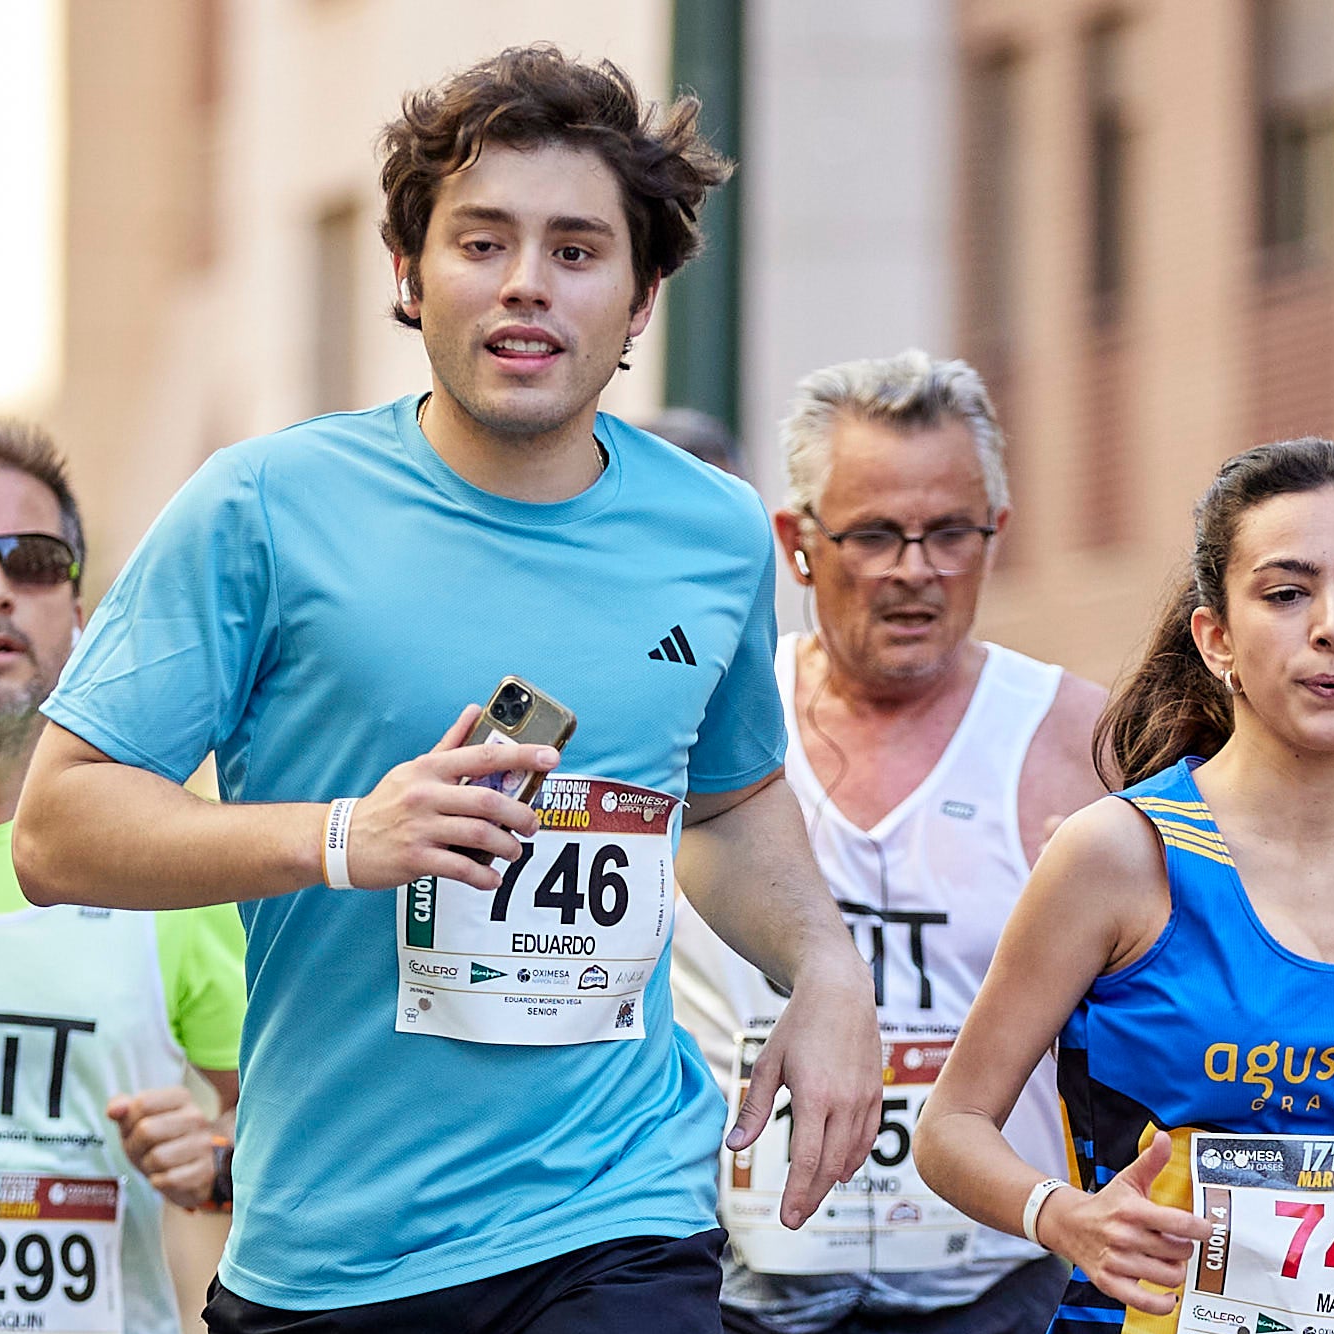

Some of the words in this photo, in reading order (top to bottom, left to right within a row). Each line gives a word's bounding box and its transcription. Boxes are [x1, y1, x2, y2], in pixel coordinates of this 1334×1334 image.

[542, 780, 590, 794] MEMORIAL
[543, 792, 587, 811] PADRE
[618, 792, 669, 807] OXIMESA
[534, 808, 591, 828] RCELINO
[617, 805, 642, 814] NIPPON
[489, 841, 629, 927] 746
[411, 876, 432, 922] CAJÓ
[511, 933, 596, 956] EDUARDO
[411, 962, 459, 977] CALERO
[532, 969, 570, 979] OXIMESA
[504, 996, 538, 1005] EDUARDO
[539, 997, 565, 1005] MORENO
[527, 1007, 558, 1016] SENIOR
[1302, 1142, 1333, 1172] 17
[1256, 1162, 1284, 1172] GASES
[1211, 1206, 1227, 1219] 4
[1196, 1307, 1246, 1325] CALERO
